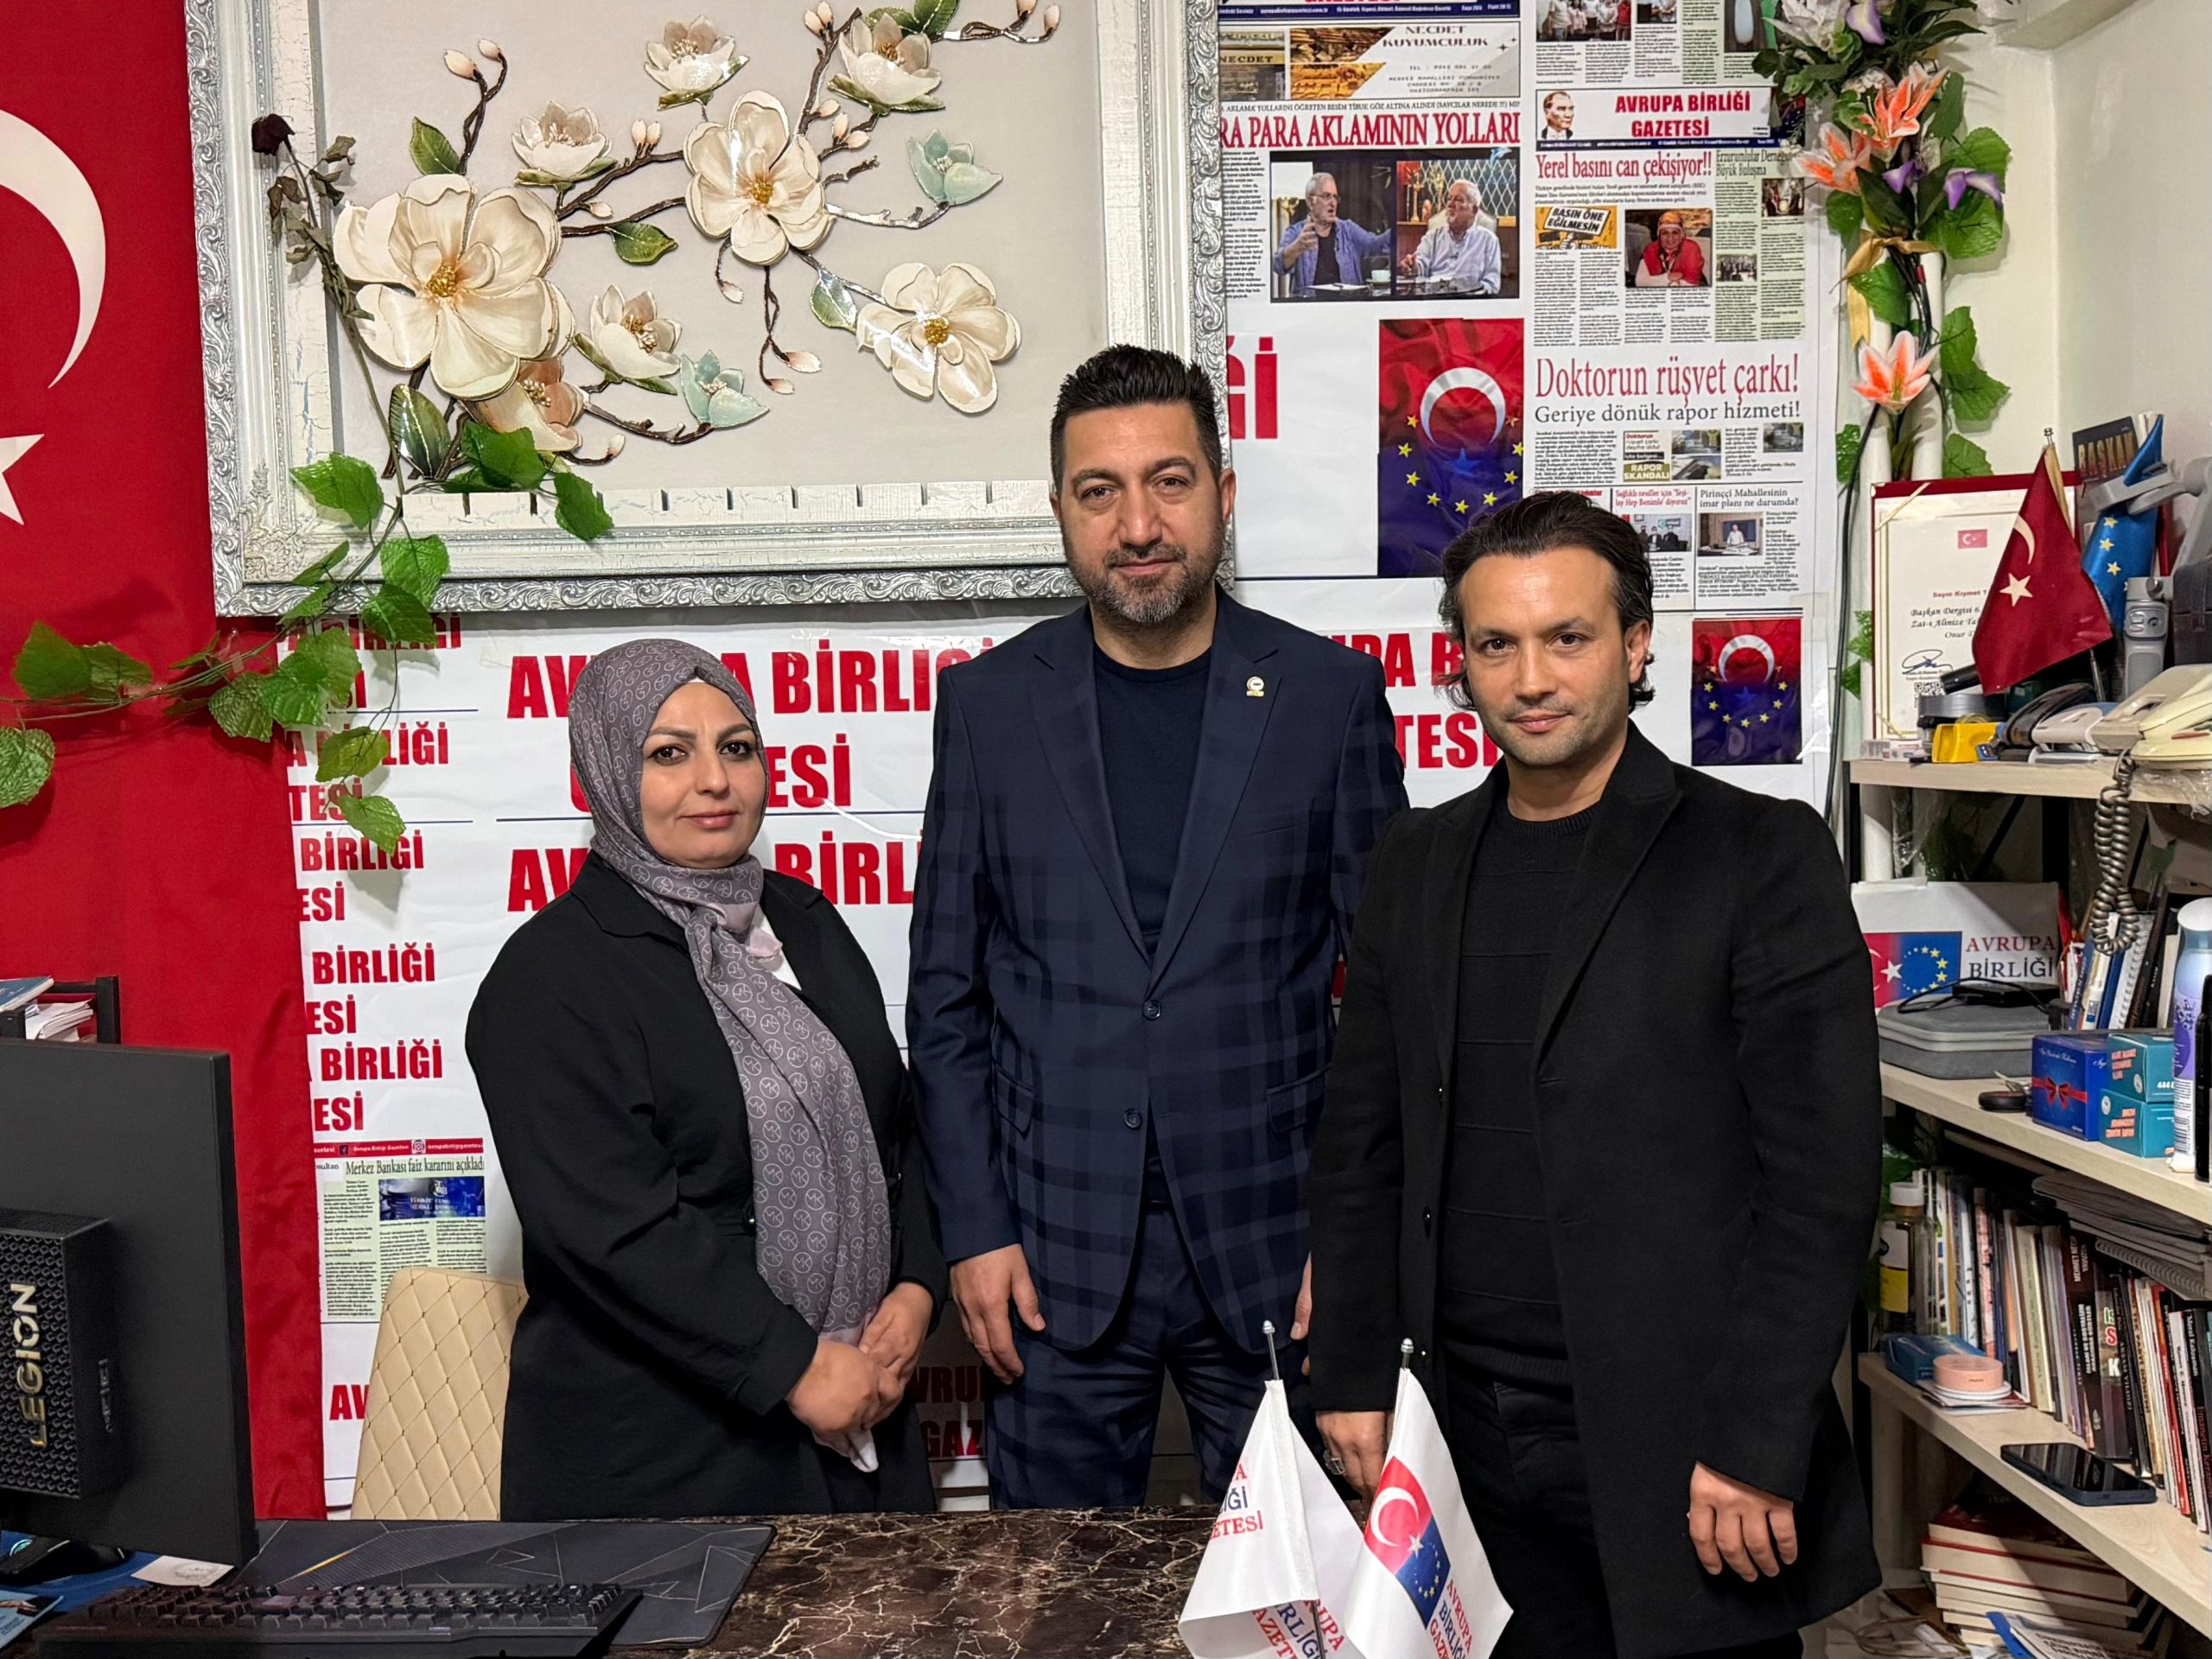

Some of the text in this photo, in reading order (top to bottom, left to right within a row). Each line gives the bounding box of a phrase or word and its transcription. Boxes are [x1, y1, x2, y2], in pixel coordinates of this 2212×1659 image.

[1382, 38, 1488, 48] KUYUMCULUK
[1406, 26, 1467, 35] NECDET
[1614, 91, 1751, 114] AVRUPA BİRLİĞİ
[1221, 111, 1522, 149] RA PARA AKLAMININ YOLLARI
[1631, 117, 1710, 138] GAZETESİ
[1535, 151, 1713, 184] Yerel basını can çekişiyor!!
[1547, 216, 1599, 232] EĞİLMESİN
[1552, 207, 1605, 222] BASIN ÖNE
[1535, 353, 1800, 408] Doktorun rüşvet çarkı!
[1535, 400, 1801, 427] Geriye dönük rapor hizmeti!
[1624, 471, 1669, 480] SKANDALI
[1630, 463, 1662, 472] RAPOR
[1700, 499, 1719, 508] imar
[1734, 487, 1788, 499] Mahallesinin
[298, 880, 346, 922] ESİ
[1965, 935, 2056, 952] AVRUPA
[312, 942, 436, 985] BİRLİĞİ
[1968, 957, 2054, 978] BİRLİĞİ
[305, 994, 357, 1035] ESİ
[321, 1038, 443, 1082] BİRLİĞİ
[314, 1090, 365, 1132] ESİ
[346, 1160, 375, 1175] Merkez
[376, 1159, 407, 1174] Bankası
[408, 1158, 423, 1173] faiz
[424, 1156, 454, 1172] kararını
[10, 1282, 48, 1447] LEGION
[328, 1384, 371, 1421] AV
[919, 1419, 984, 1458] GAZ
[1211, 1510, 1264, 1539] ETESİ
